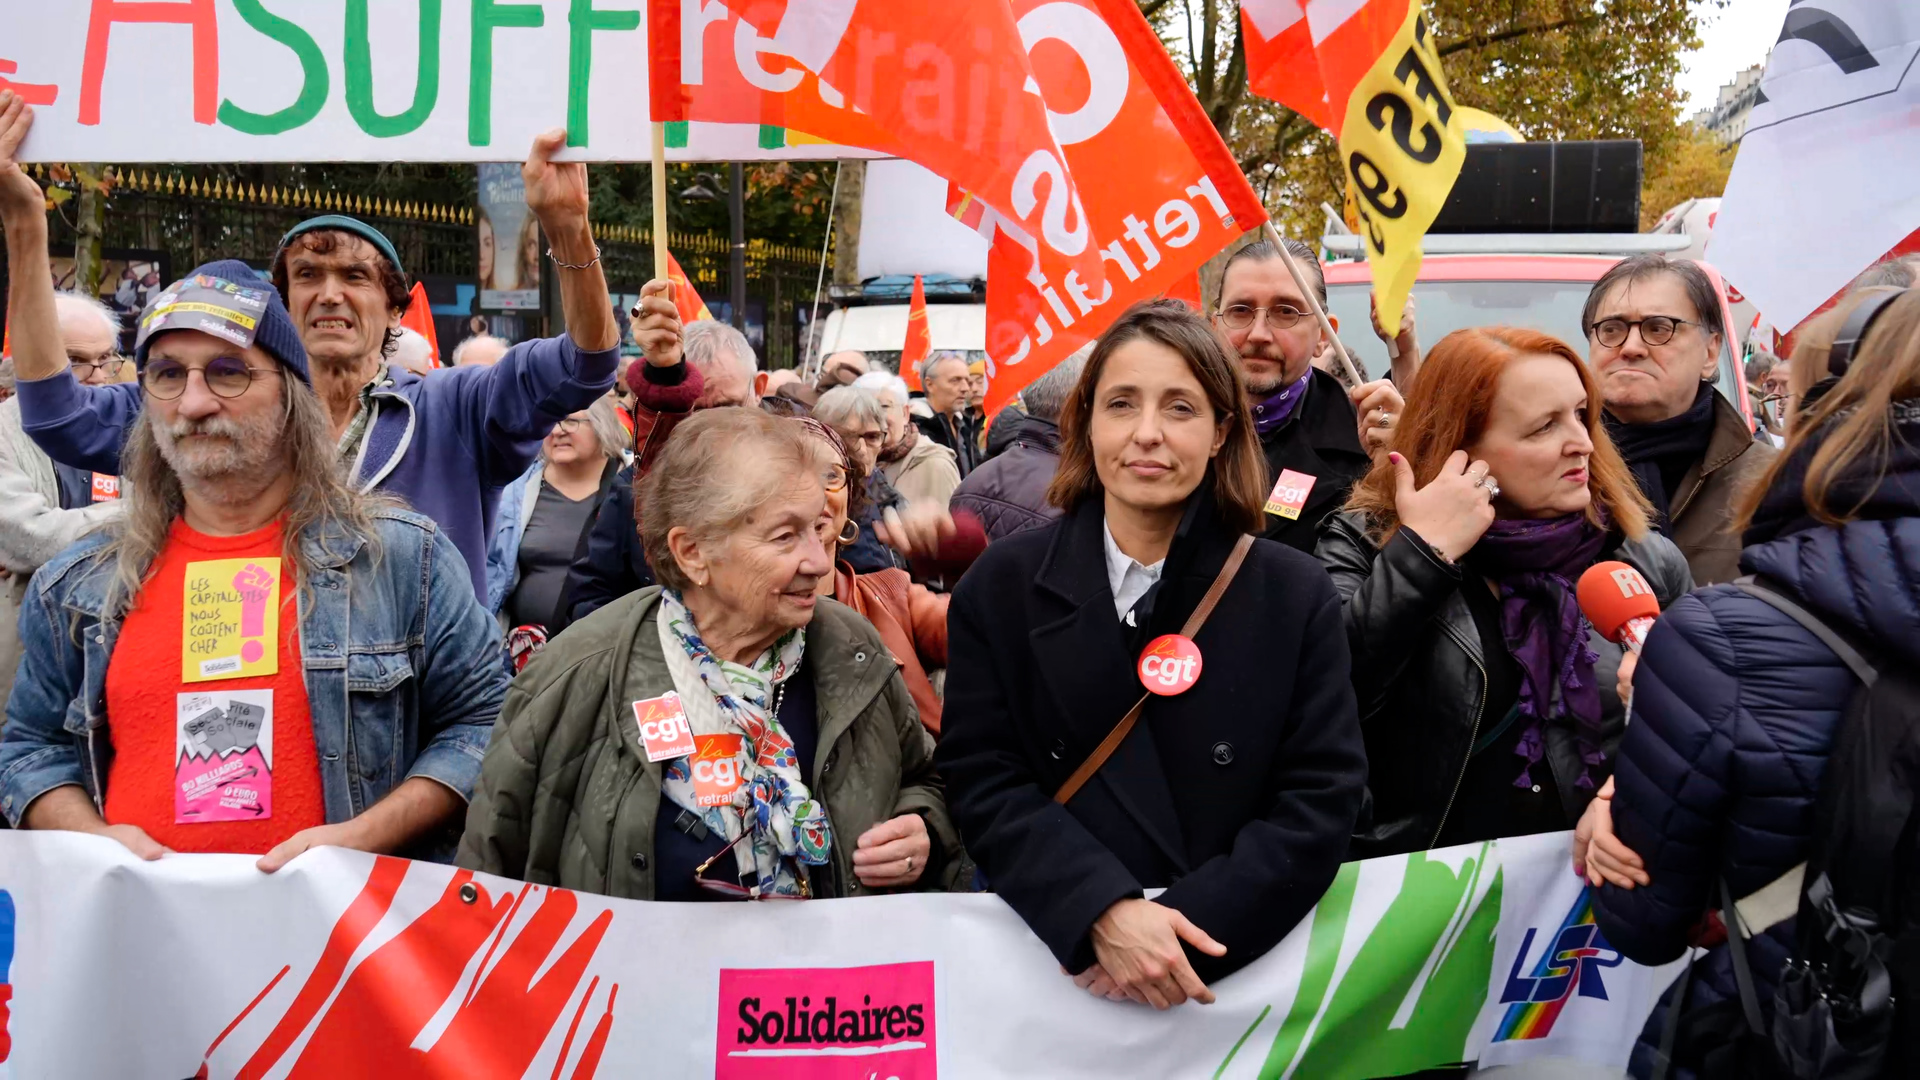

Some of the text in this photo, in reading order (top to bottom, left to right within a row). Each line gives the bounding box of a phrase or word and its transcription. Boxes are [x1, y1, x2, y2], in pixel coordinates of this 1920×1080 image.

[1274, 485, 1307, 503] cgt
[1266, 501, 1298, 517] UD 95
[190, 577, 210, 592] LES
[190, 608, 221, 623] NOUS
[190, 621, 238, 637] COÛTENT
[190, 639, 218, 654] CHER
[1141, 654, 1197, 686] cgt
[641, 712, 690, 742] cgt
[695, 738, 737, 761] la
[195, 758, 245, 783] MILLIARDS
[698, 791, 735, 806] retrai
[1499, 924, 1625, 1005] LSR
[737, 995, 925, 1044] Solidaires
